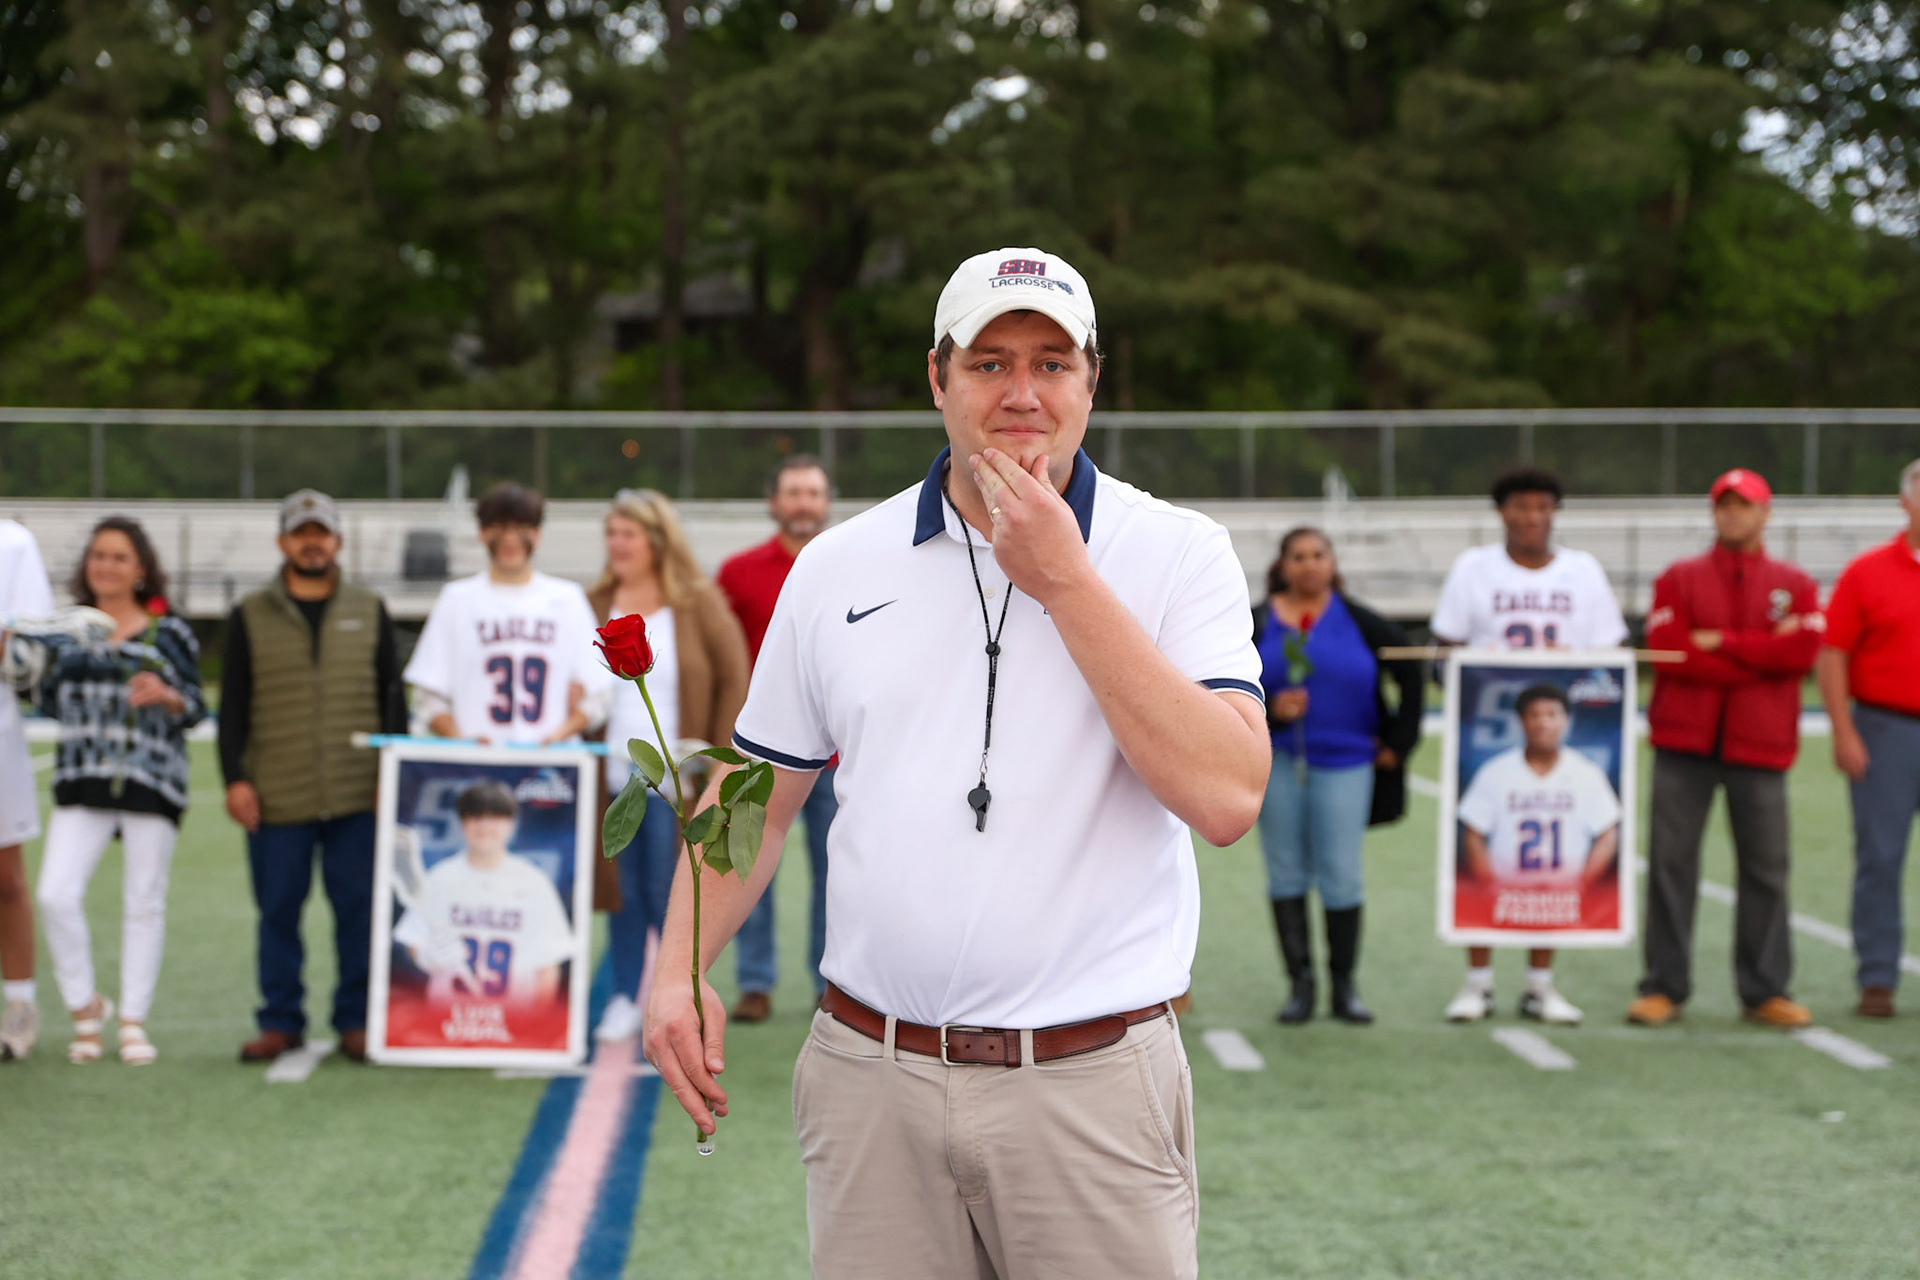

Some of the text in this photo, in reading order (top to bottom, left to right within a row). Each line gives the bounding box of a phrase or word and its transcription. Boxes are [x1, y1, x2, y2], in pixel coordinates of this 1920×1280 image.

[991, 277, 1054, 291] LACROSSE
[998, 259, 1046, 276] SBA
[485, 654, 547, 725] 39
[1517, 819, 1561, 871] 21
